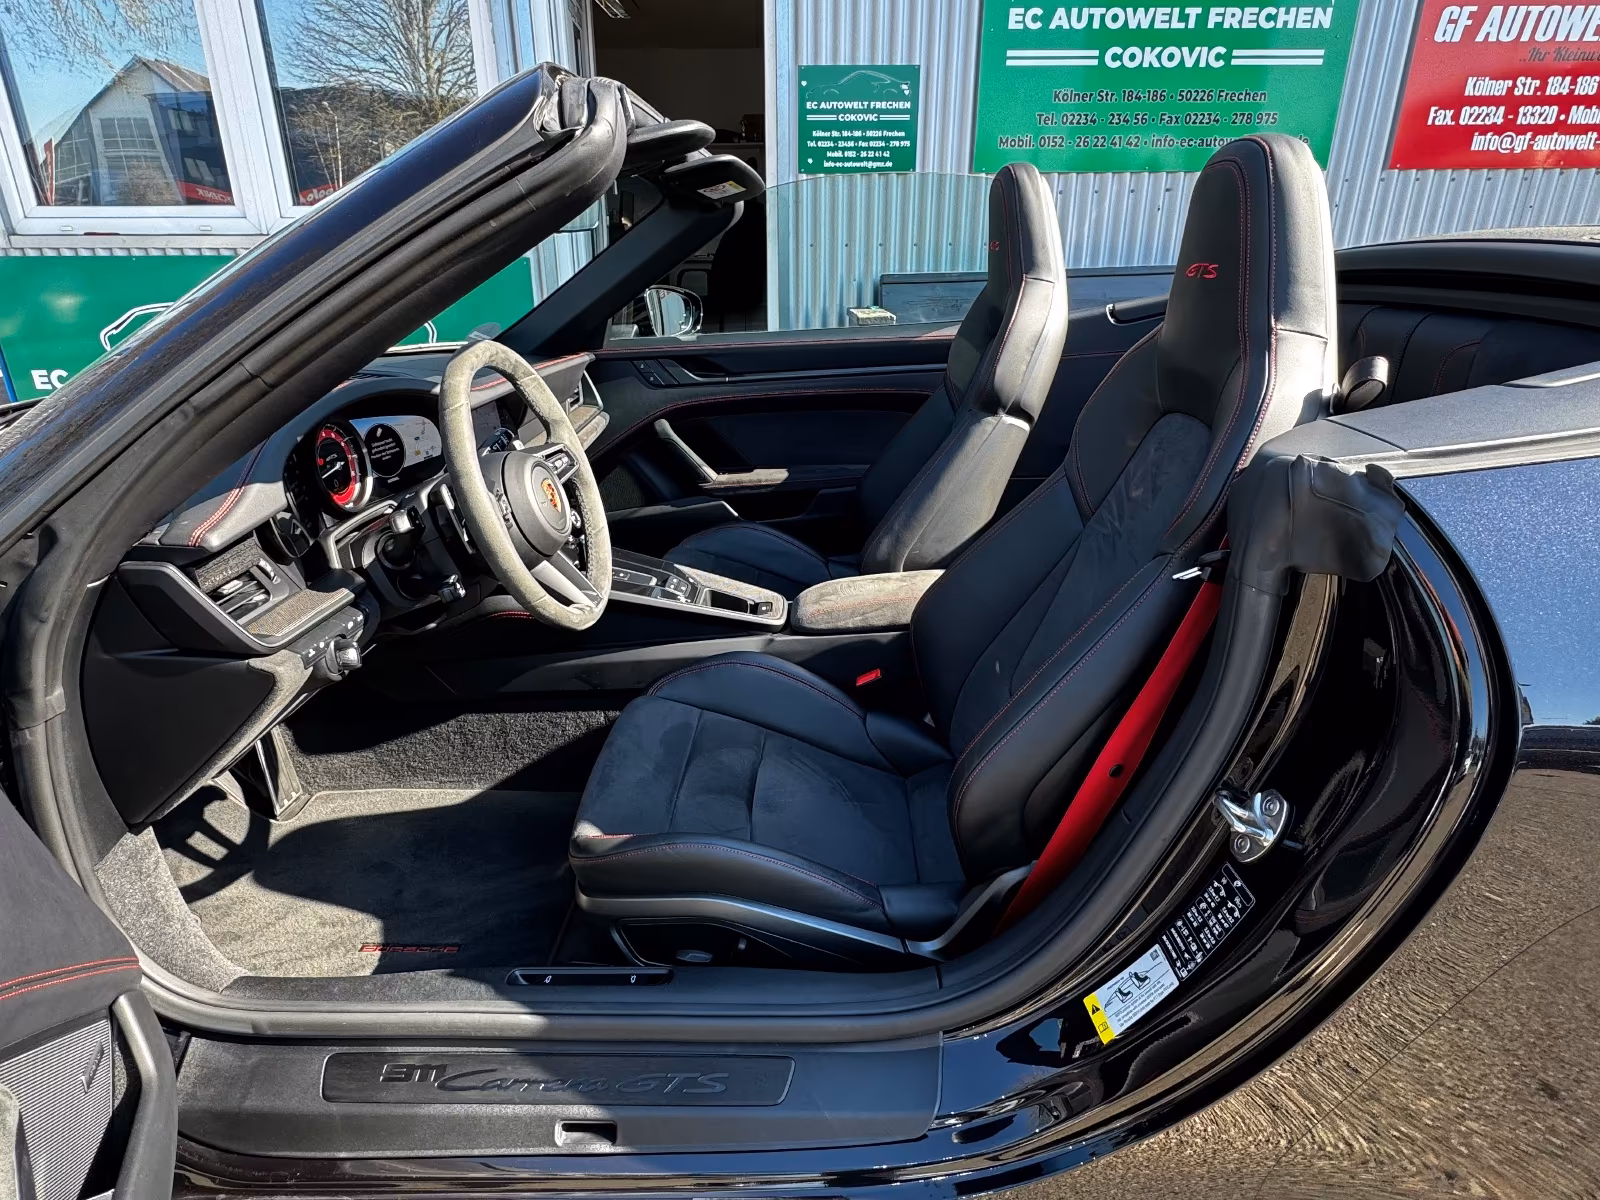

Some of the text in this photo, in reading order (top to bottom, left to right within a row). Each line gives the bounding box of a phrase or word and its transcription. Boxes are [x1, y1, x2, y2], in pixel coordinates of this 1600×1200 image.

[1007, 6, 1333, 30] EC AUTOWELT FRECHEN
[1433, 5, 1600, 43] GF AUTOWE
[1104, 46, 1227, 68] COKOVIC
[1052, 88, 1267, 103] Kölner Str. 184-186 50226 Frechen
[1464, 75, 1600, 97] Kölner Str. 184-186
[806, 101, 911, 109] EC AUTOWELT FRECHEN
[838, 113, 879, 122] COKOVIC
[1036, 112, 1058, 126] Tel.
[1061, 112, 1098, 126] 02234
[1107, 113, 1130, 126] 234
[1133, 113, 1148, 126] 56
[1159, 112, 1181, 126] Fax
[1184, 112, 1220, 126] 02234
[1230, 112, 1253, 125] 278
[1255, 112, 1278, 125] 975
[1426, 107, 1455, 126] Fax.
[1458, 106, 1505, 125] 02234
[1516, 106, 1559, 125] 13320
[998, 134, 1035, 149] Mobil.
[1038, 135, 1065, 149] 0152
[1075, 135, 1090, 148] 26
[1092, 135, 1108, 148] 22
[1109, 135, 1123, 148] 41
[1125, 134, 1141, 148] 42
[1186, 262, 1219, 279] GTS
[31, 369, 69, 389] EC
[615, 1072, 730, 1094] GTS
